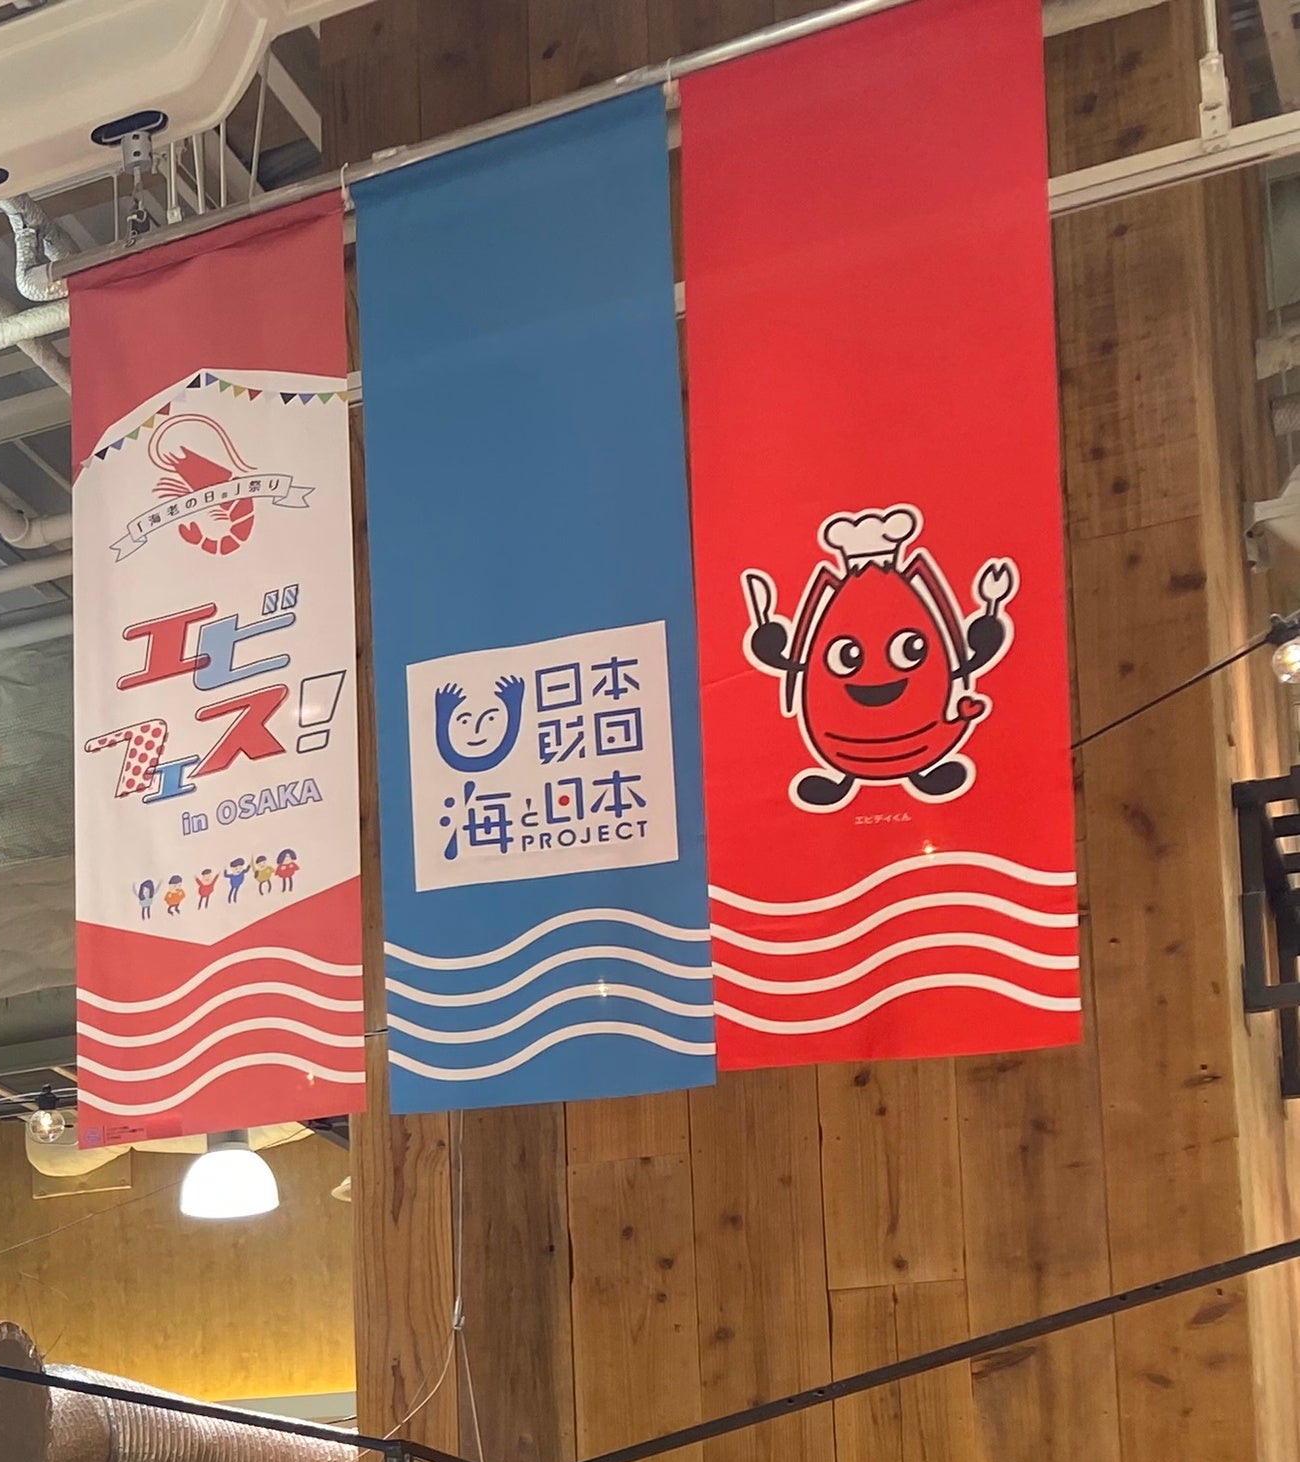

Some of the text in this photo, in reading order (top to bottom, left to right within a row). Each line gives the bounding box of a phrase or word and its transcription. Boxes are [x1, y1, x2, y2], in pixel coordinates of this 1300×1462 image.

[117, 583, 299, 691] エビ
[534, 655, 641, 713] 日本
[181, 777, 324, 836] in OSAKA
[439, 769, 648, 861] 海と日本
[521, 820, 649, 852] PROJECT
